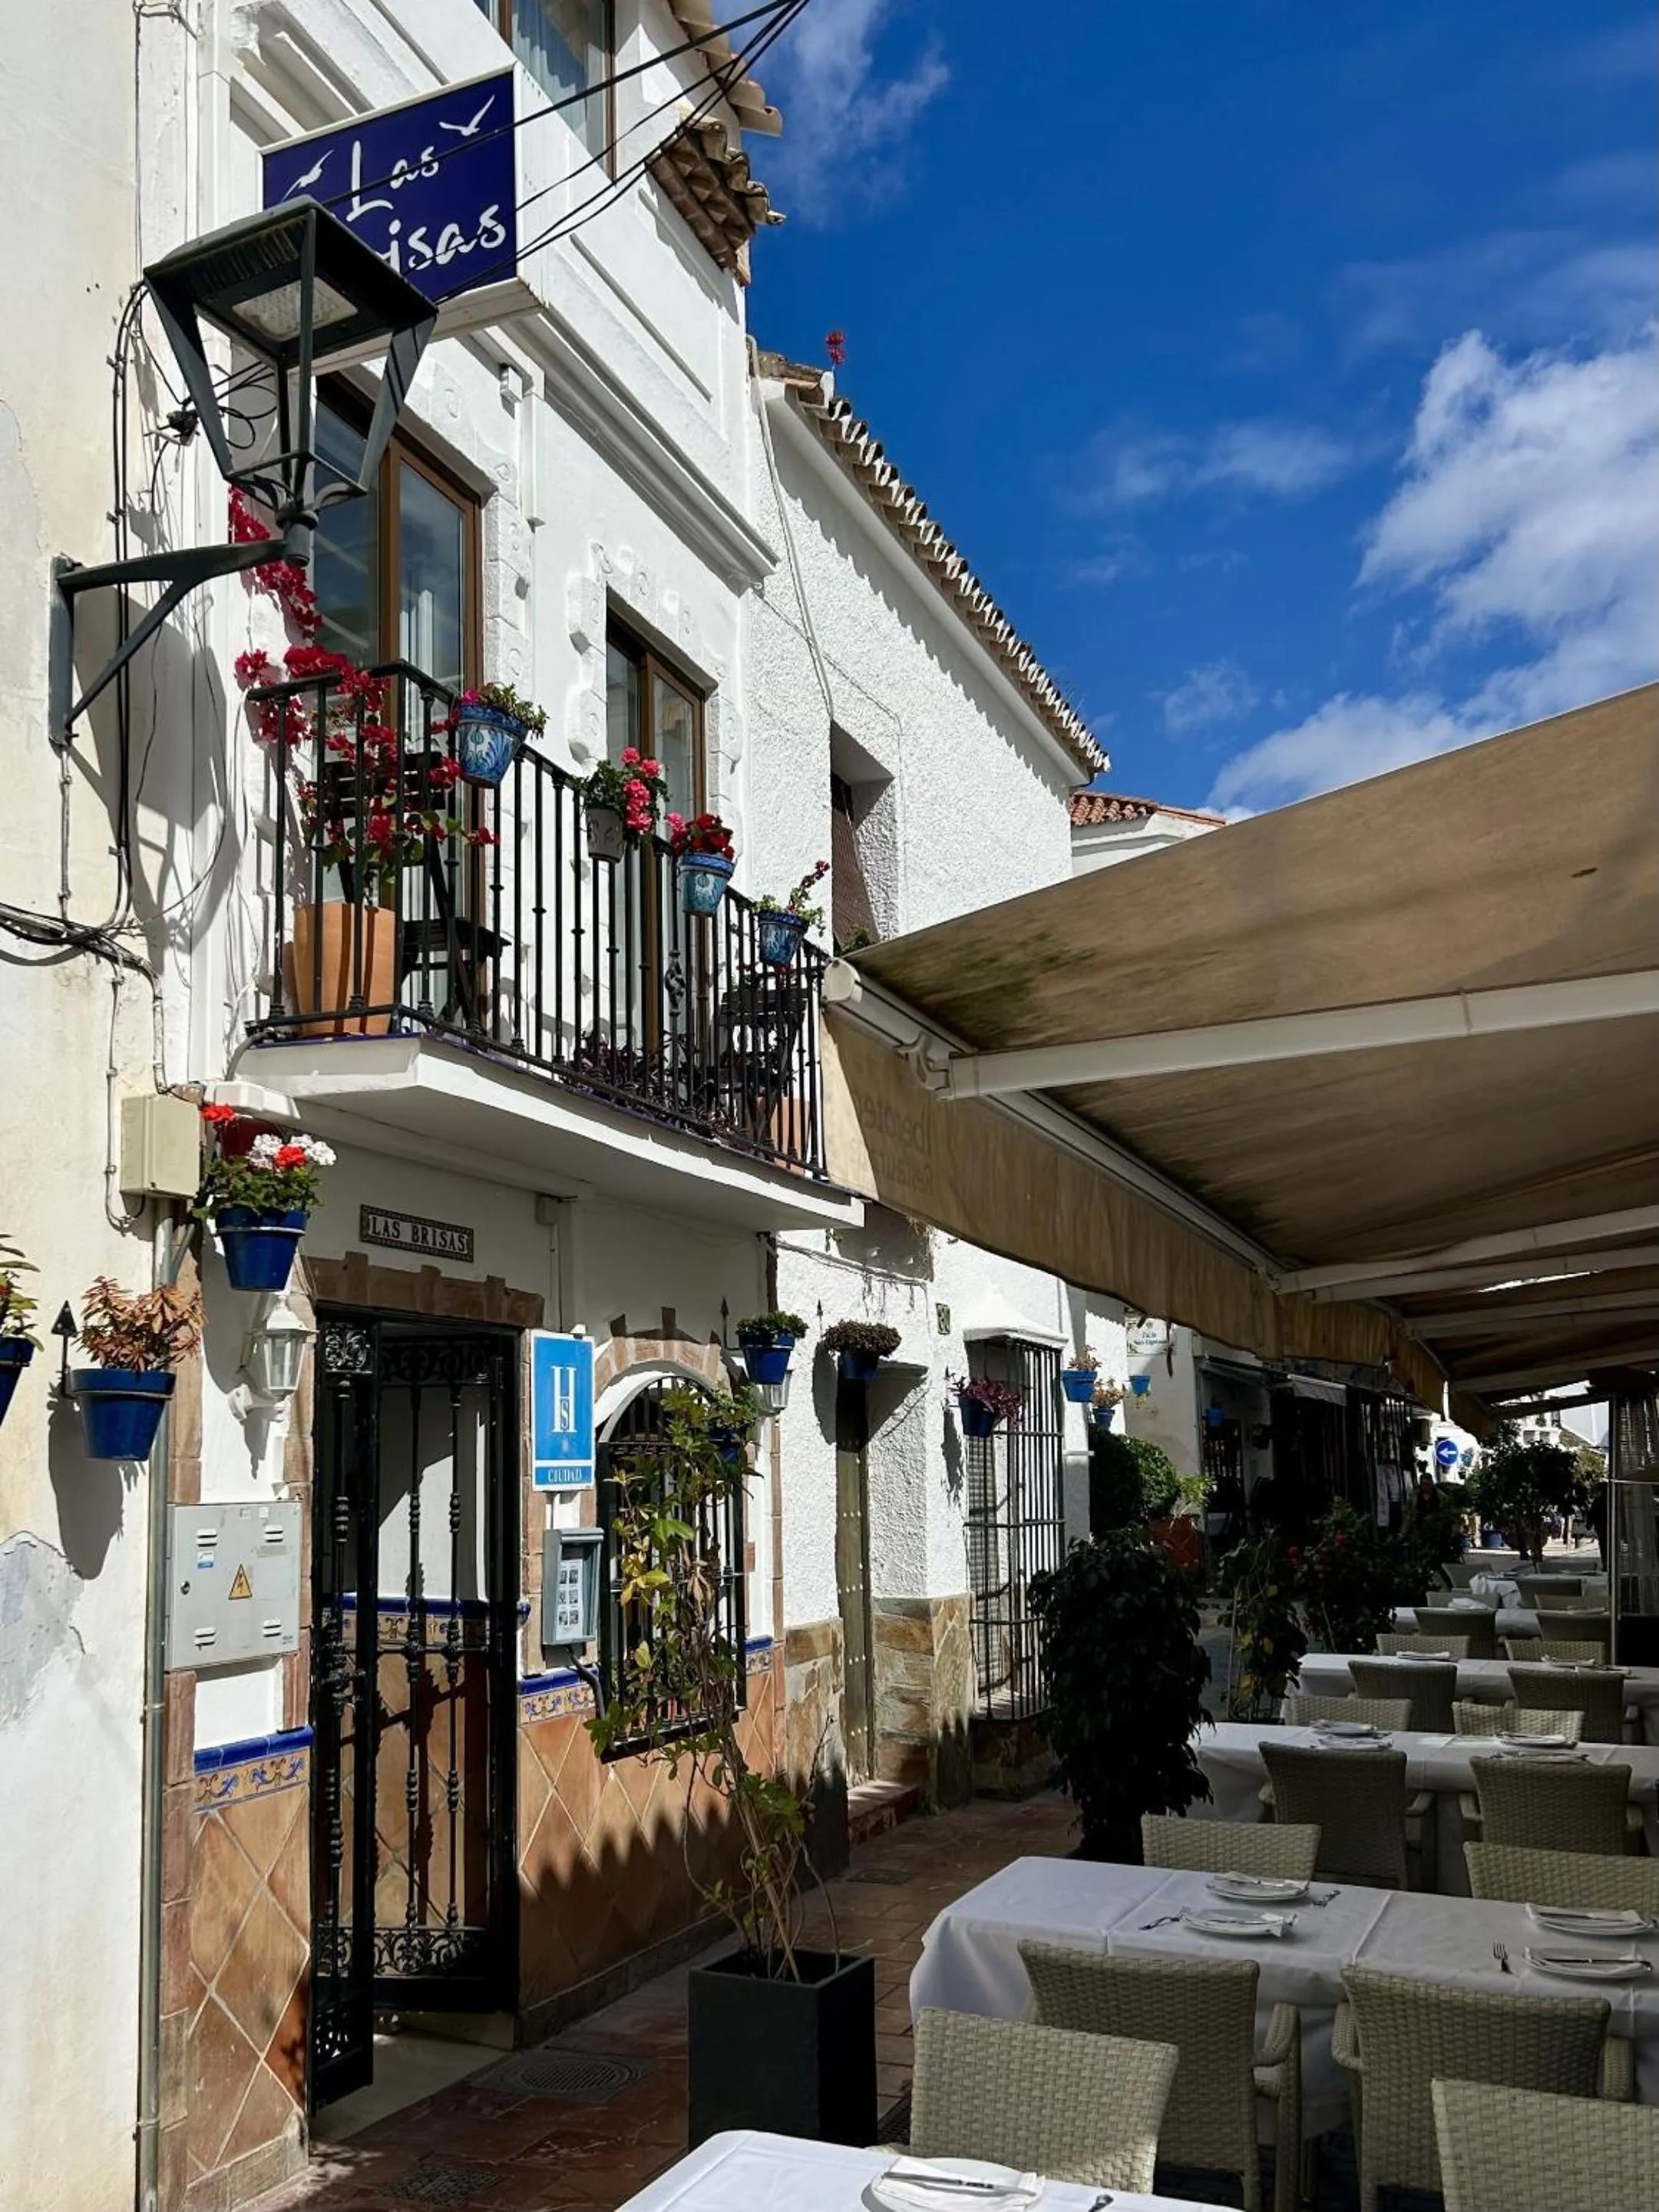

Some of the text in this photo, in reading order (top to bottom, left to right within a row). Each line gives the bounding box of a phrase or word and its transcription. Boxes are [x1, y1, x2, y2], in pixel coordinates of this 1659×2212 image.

[346, 140, 440, 222] Las
[376, 203, 507, 276] isas
[372, 1216, 466, 1252] LAS BRISAS
[547, 1469, 583, 1483] CIUDAD
